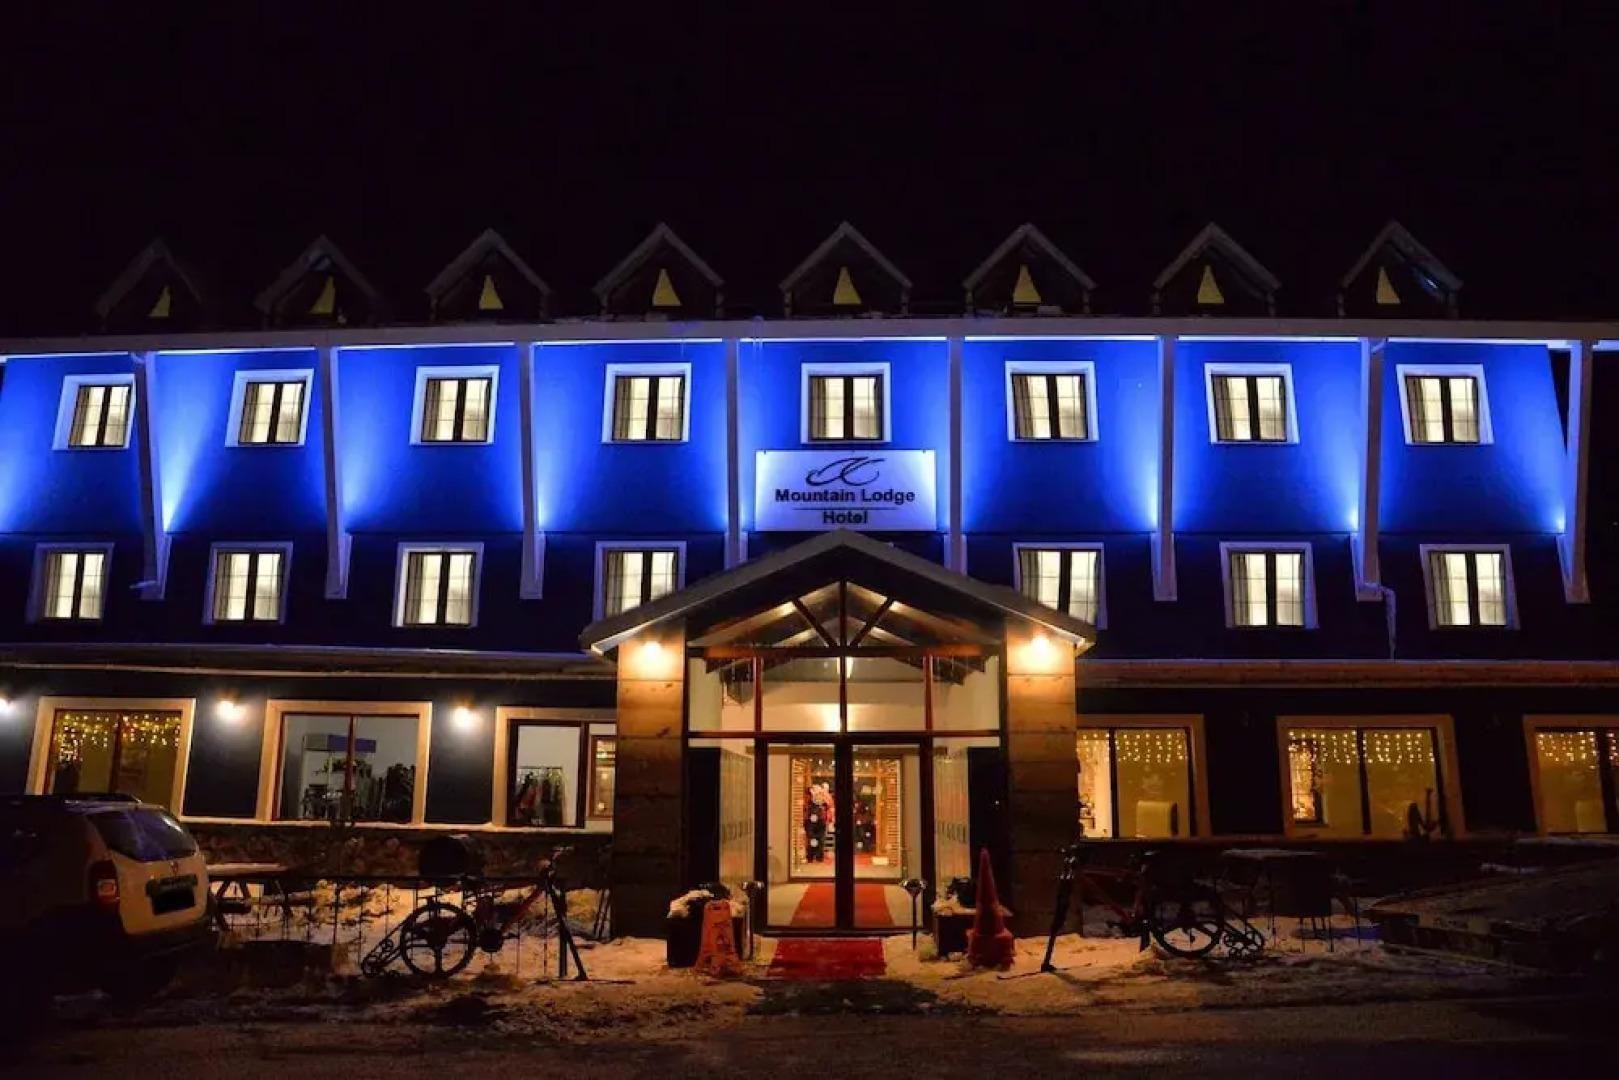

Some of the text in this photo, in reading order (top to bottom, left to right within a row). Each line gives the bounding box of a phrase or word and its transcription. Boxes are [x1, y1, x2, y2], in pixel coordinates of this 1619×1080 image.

[775, 489, 915, 505] Mountain Lodge
[823, 510, 868, 524] Hotel
